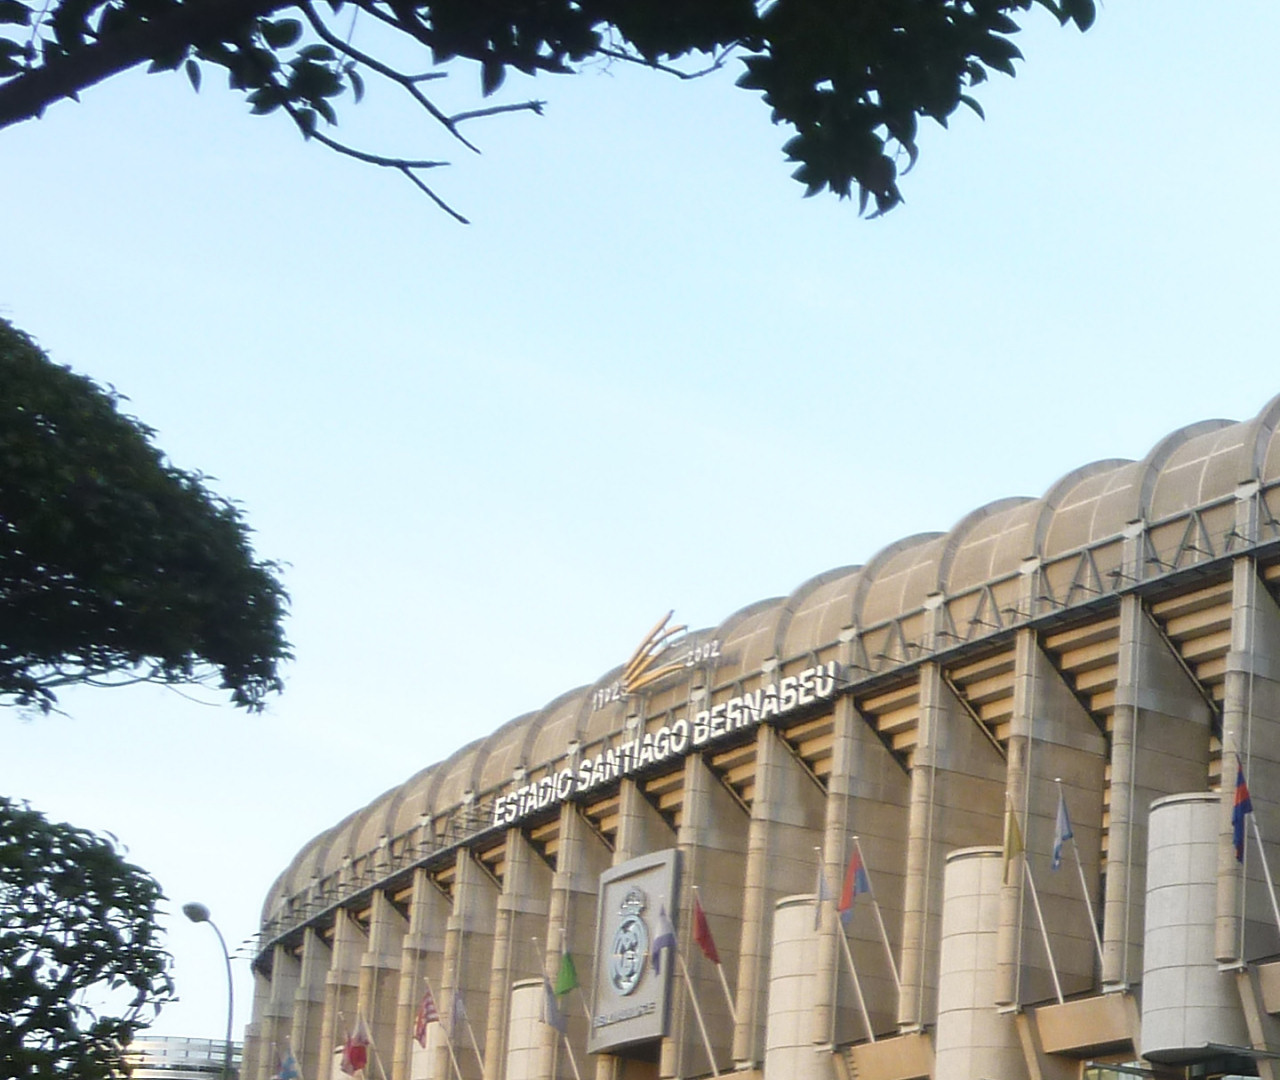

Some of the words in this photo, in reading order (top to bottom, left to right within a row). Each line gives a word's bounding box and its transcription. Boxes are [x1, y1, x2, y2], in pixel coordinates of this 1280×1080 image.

[685, 640, 720, 667] 2002
[493, 768, 572, 827] ESTADIO
[575, 718, 690, 791] SANTIAGO
[692, 661, 840, 745] BERNABEU
